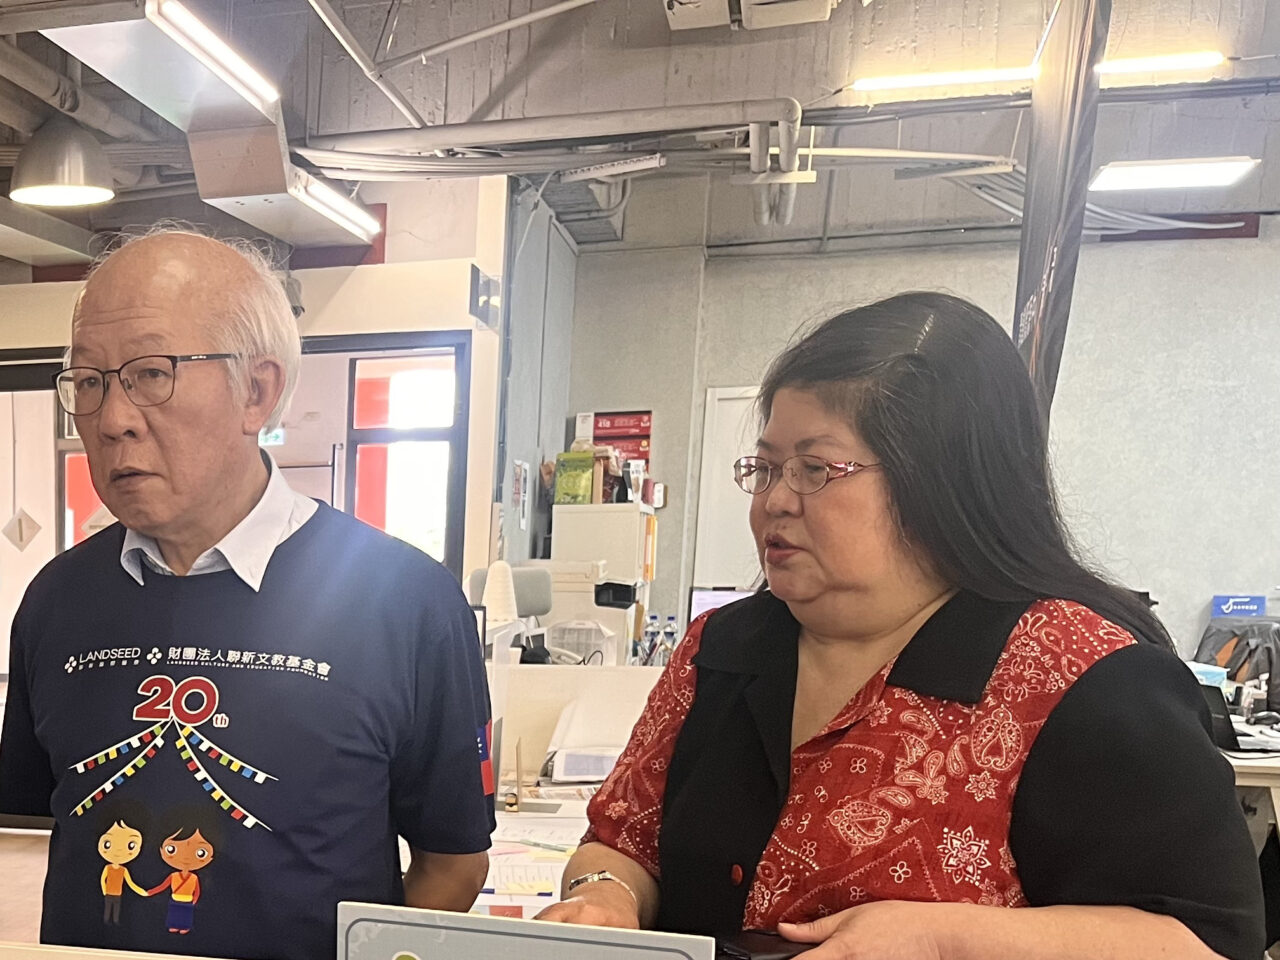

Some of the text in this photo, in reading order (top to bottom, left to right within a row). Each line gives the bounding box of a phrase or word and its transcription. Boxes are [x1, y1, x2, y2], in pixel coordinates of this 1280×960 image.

[79, 647, 141, 663] LANDSEED
[167, 647, 331, 676] 財團法人聯新文教基金會
